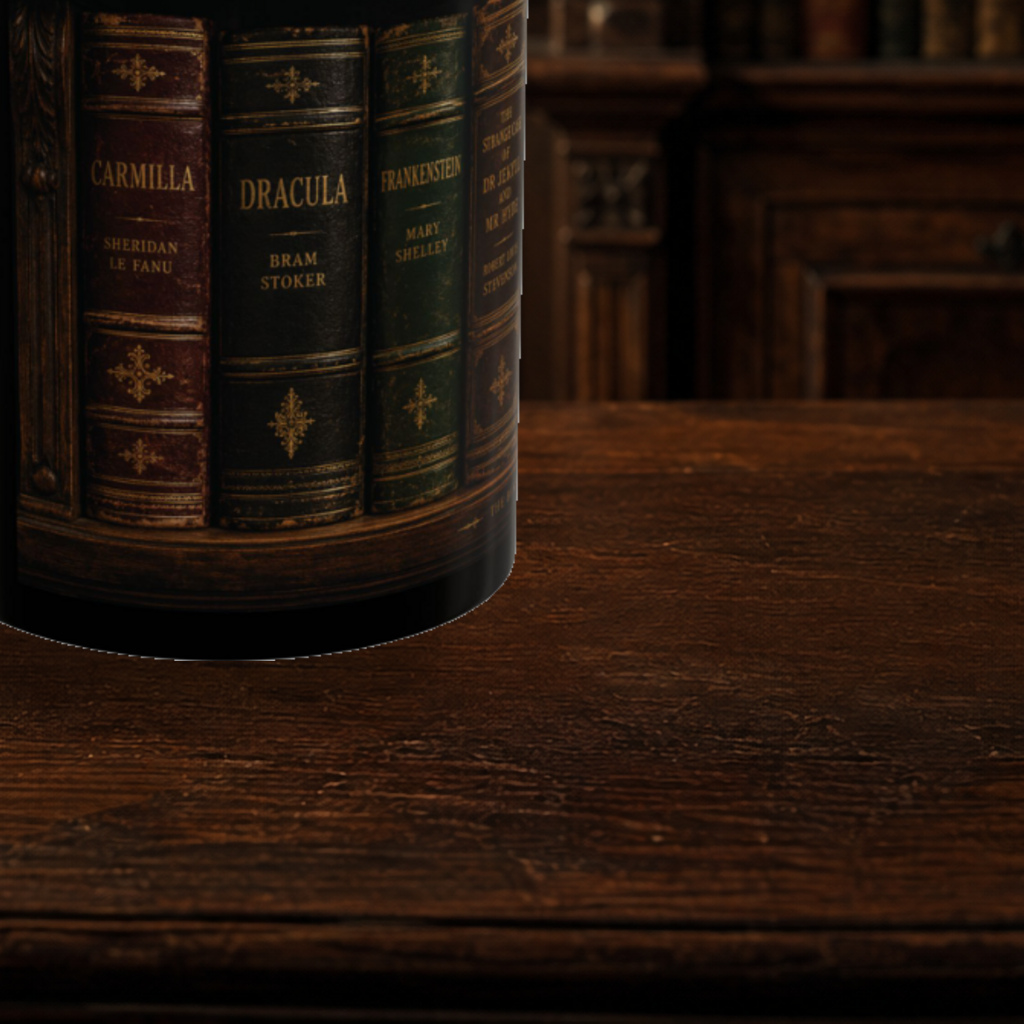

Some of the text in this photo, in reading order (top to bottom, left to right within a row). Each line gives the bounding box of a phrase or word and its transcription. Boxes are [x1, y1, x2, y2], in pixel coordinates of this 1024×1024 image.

[91, 159, 196, 192] CARMILLA
[381, 153, 462, 192] FRANKENSTEIN
[240, 173, 349, 210] DRACULA
[482, 173, 496, 194] DR
[406, 220, 441, 241] MARY
[484, 212, 499, 233] MR
[103, 236, 179, 255] SHERIDAN
[395, 237, 449, 263] SHELLEY
[109, 256, 173, 275] LE FANU
[269, 251, 318, 269] BRAM
[260, 272, 327, 291] STOKER
